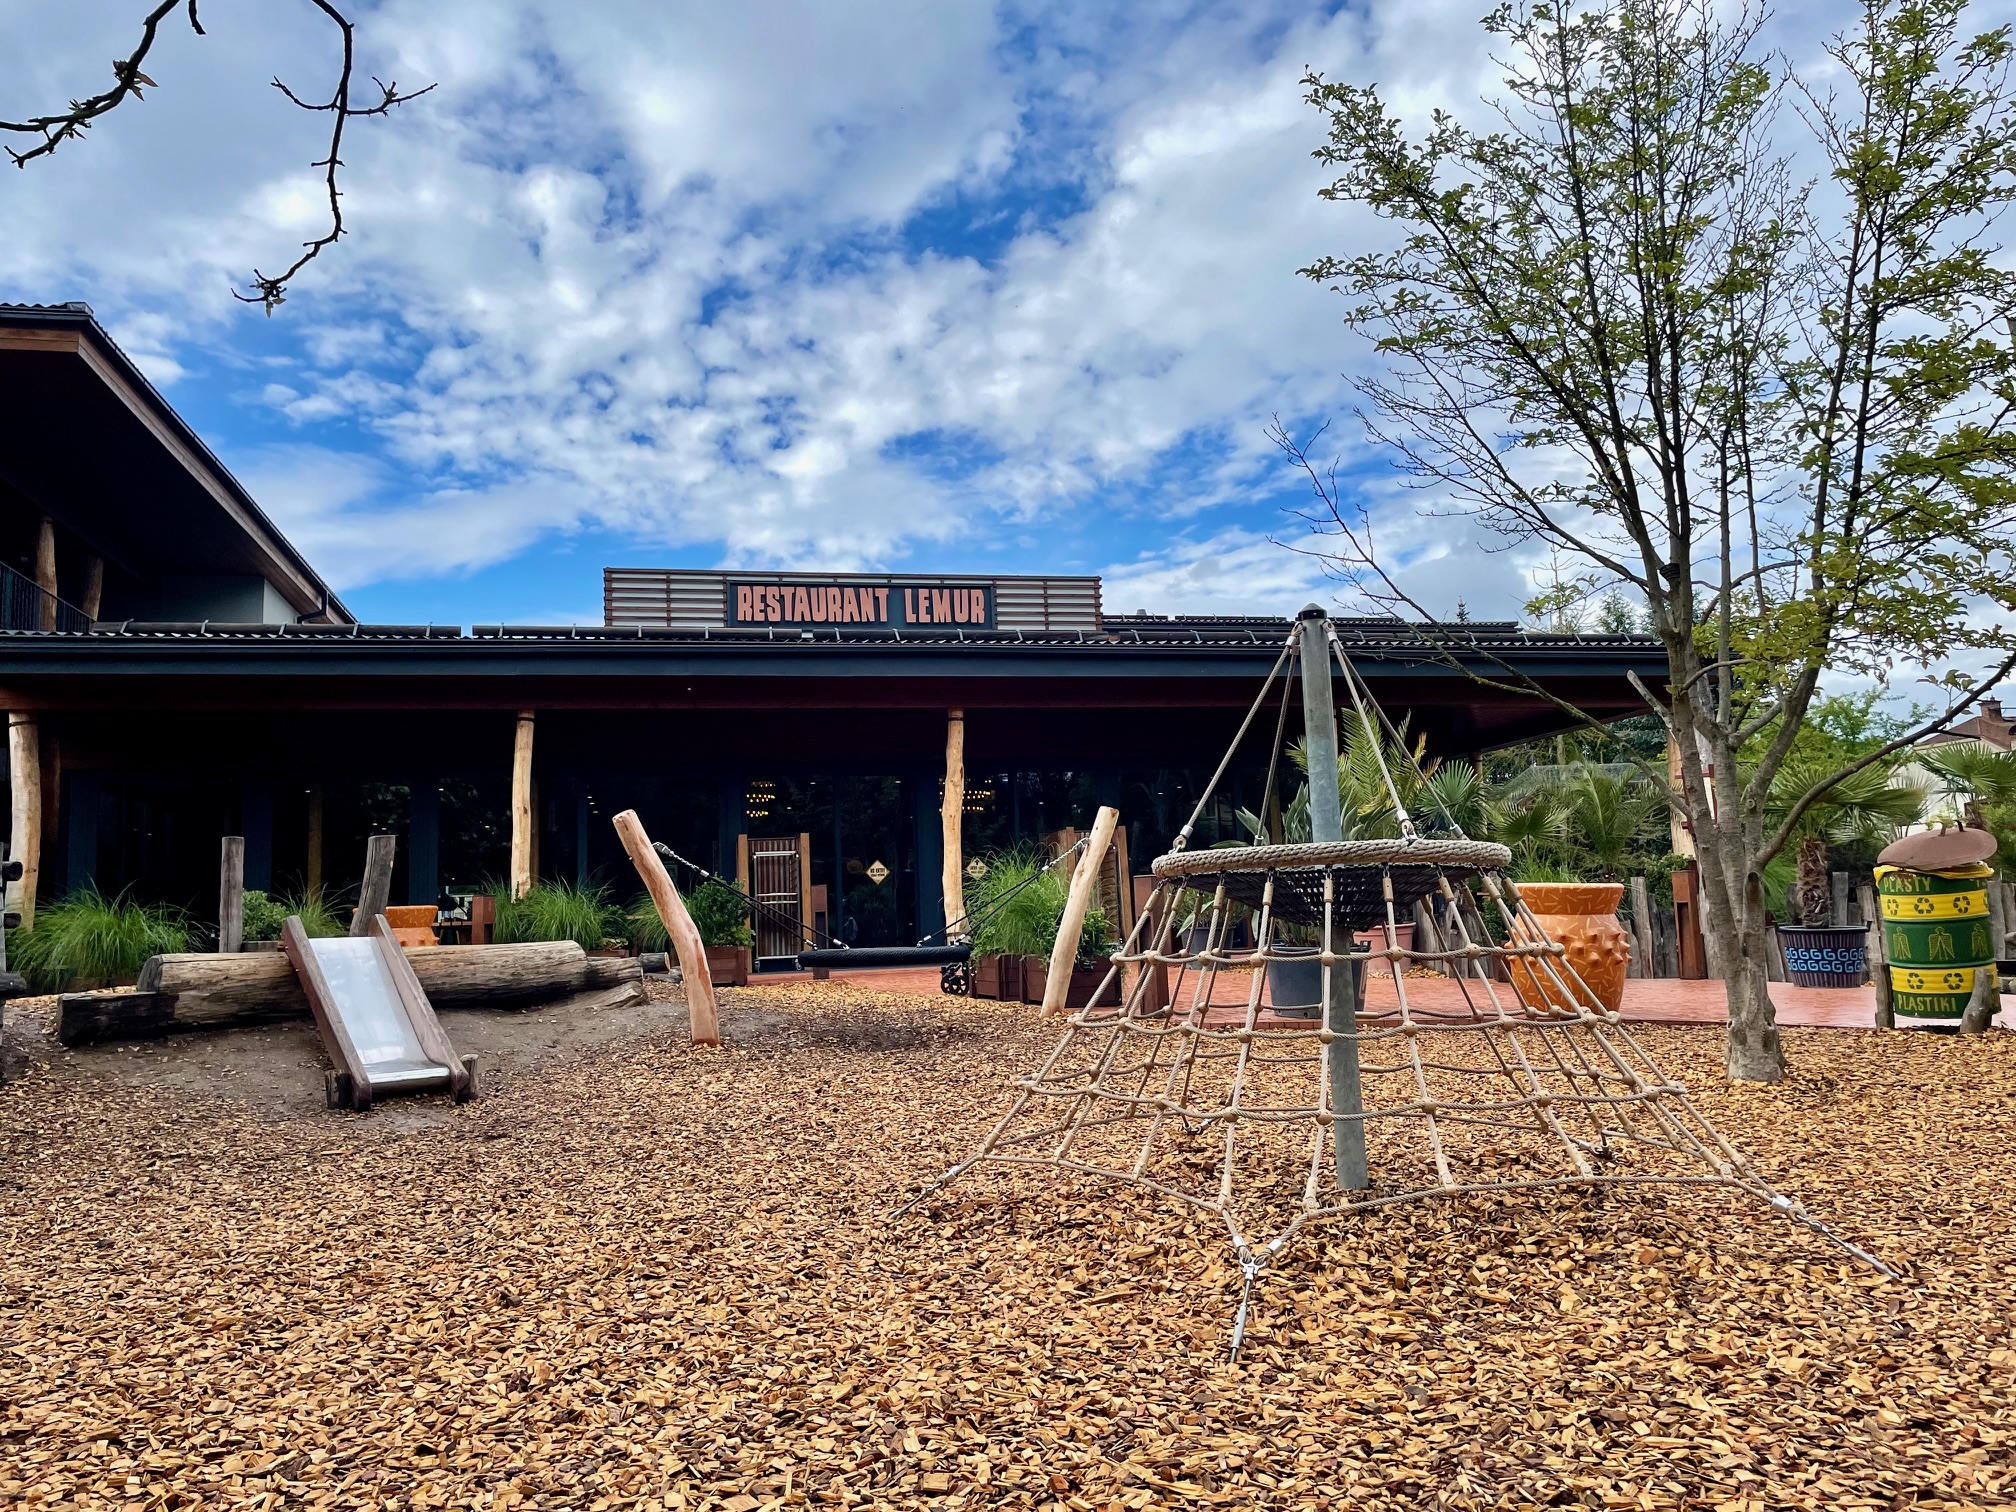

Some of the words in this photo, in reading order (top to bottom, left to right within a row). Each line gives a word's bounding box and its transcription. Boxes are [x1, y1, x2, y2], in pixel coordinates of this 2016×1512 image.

[737, 586, 889, 622] RESTAURANT
[904, 588, 985, 623] LEMUR
[1883, 877, 1931, 893] PLASTY
[1897, 994, 1957, 1012] PLASTIKI
